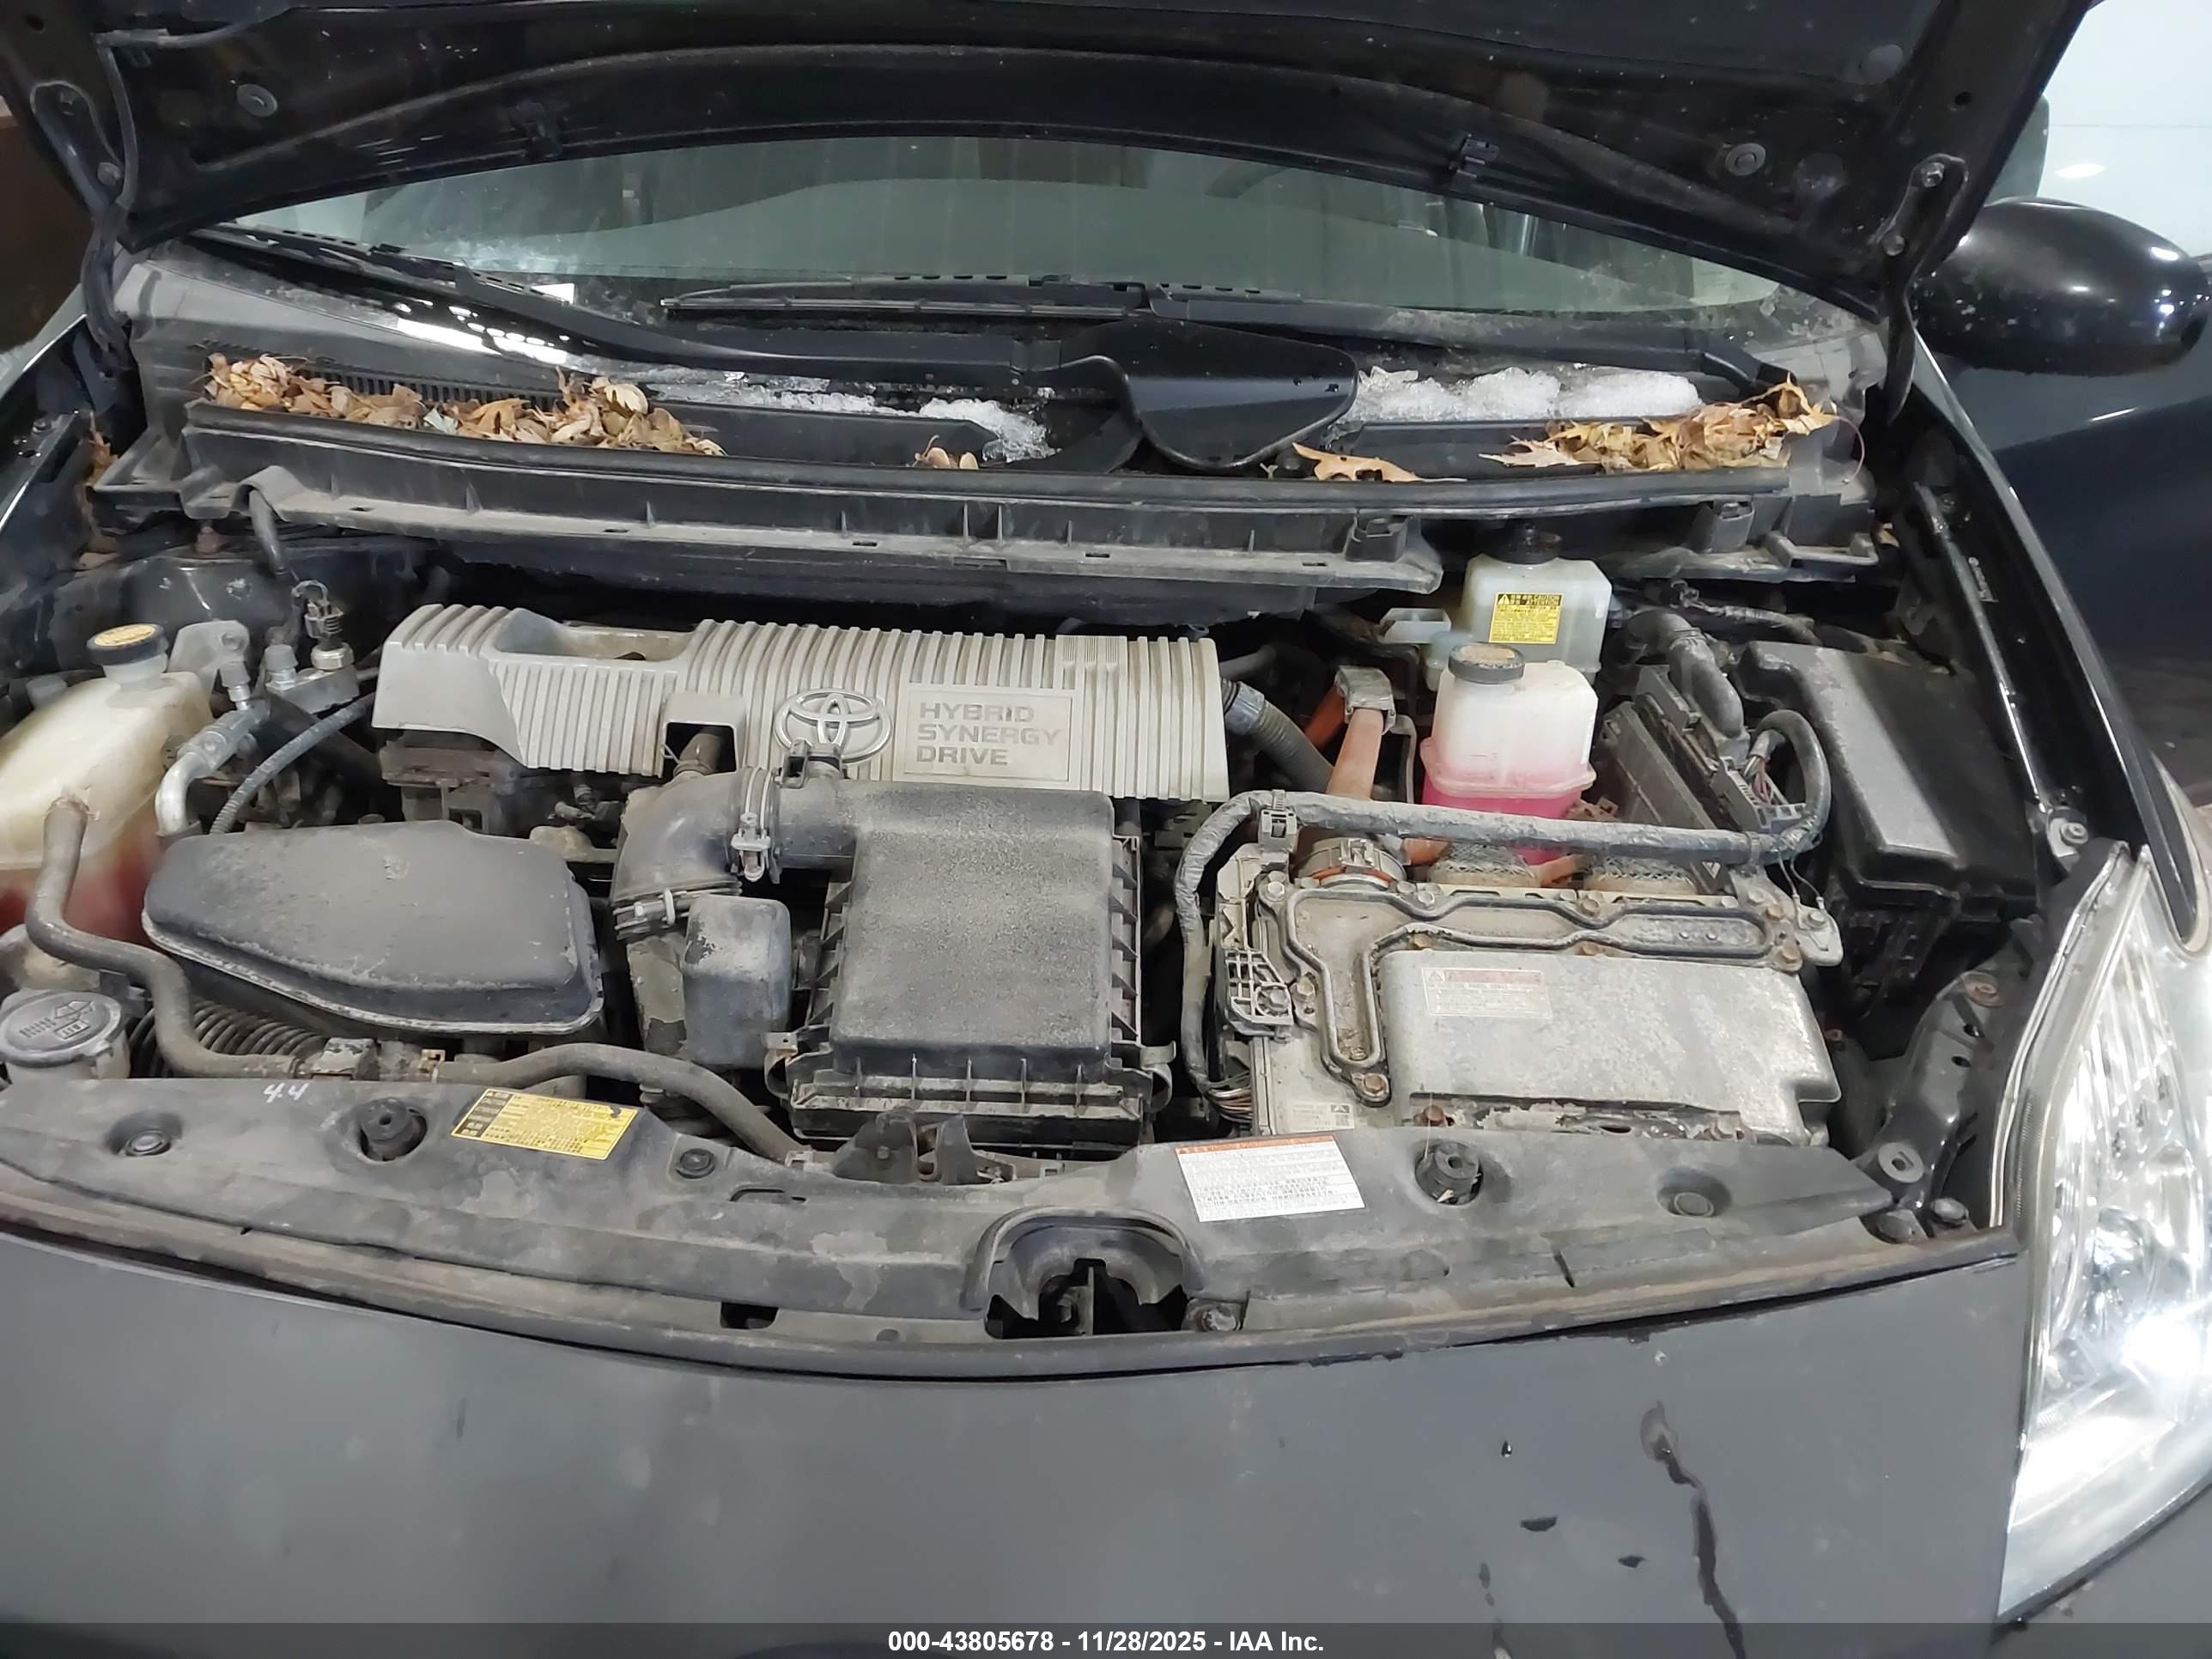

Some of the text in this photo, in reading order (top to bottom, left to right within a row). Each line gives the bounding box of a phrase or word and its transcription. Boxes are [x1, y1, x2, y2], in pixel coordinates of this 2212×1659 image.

[920, 702, 1035, 722] HYBRID
[918, 723, 1061, 745] SYNERGY
[916, 745, 1008, 765] DRIVE
